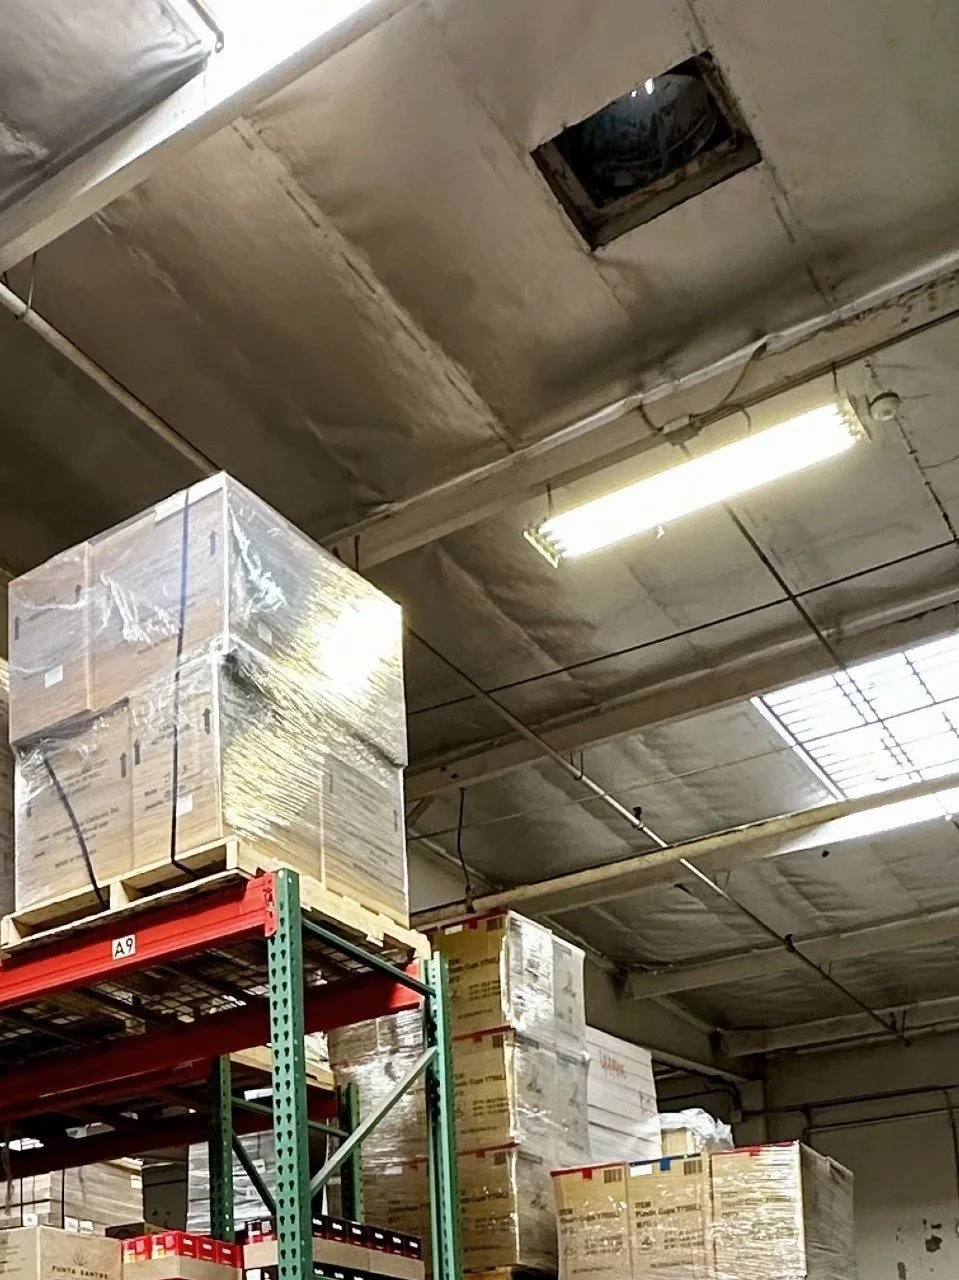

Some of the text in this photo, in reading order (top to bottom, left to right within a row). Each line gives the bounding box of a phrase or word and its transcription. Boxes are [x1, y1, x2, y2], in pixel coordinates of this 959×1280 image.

[114, 937, 133, 957] A9
[52, 1264, 109, 1280] PUNTA SANTOS
